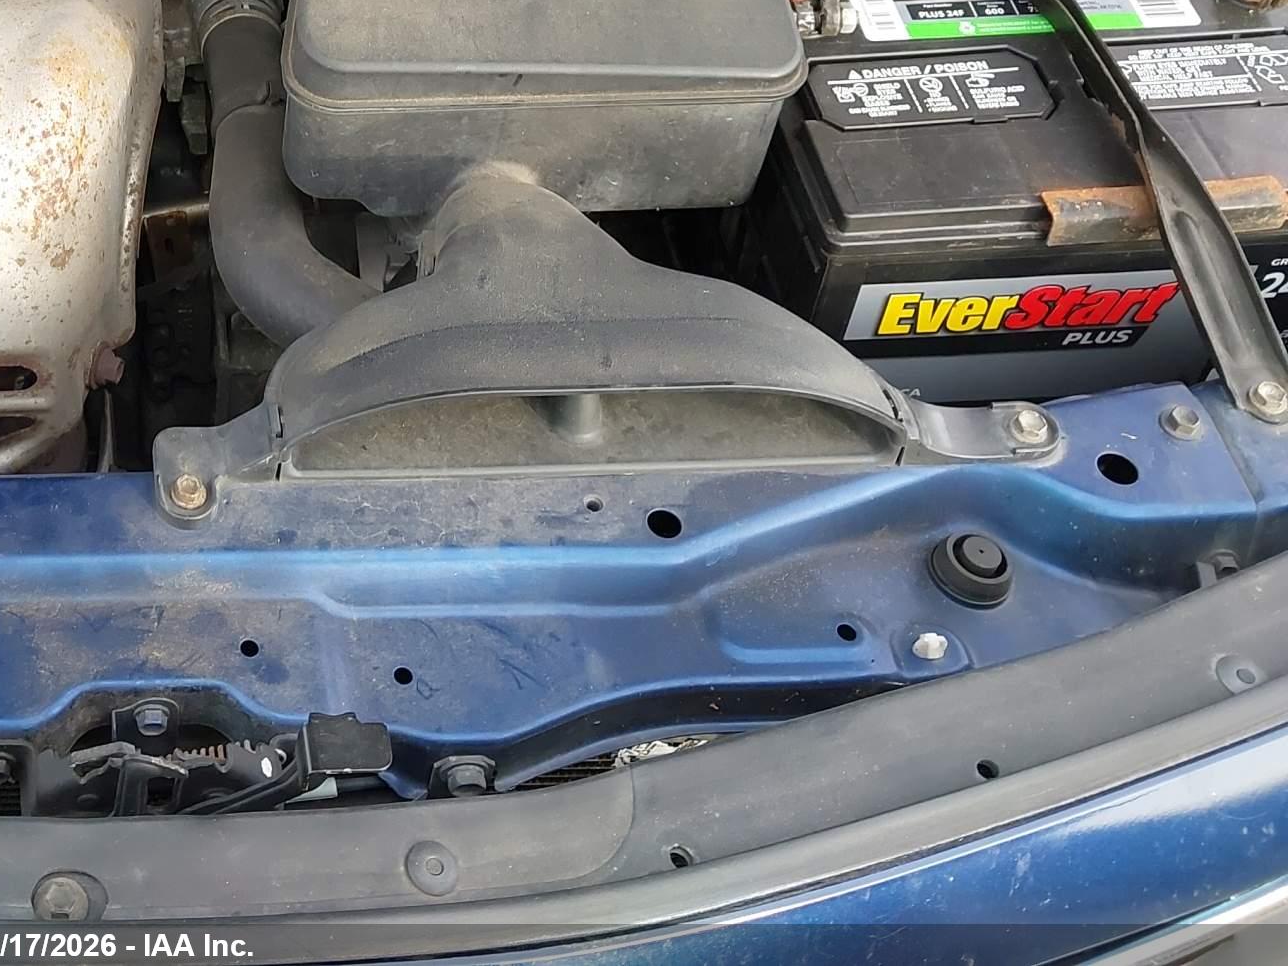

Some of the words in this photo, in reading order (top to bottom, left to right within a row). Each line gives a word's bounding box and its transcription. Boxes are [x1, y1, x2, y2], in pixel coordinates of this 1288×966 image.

[918, 10, 945, 19] PLUS
[861, 65, 921, 78] DANGER
[924, 65, 932, 74] /
[935, 61, 989, 73] POISON
[875, 280, 1180, 336] EverStart
[1061, 329, 1134, 346] PLUS
